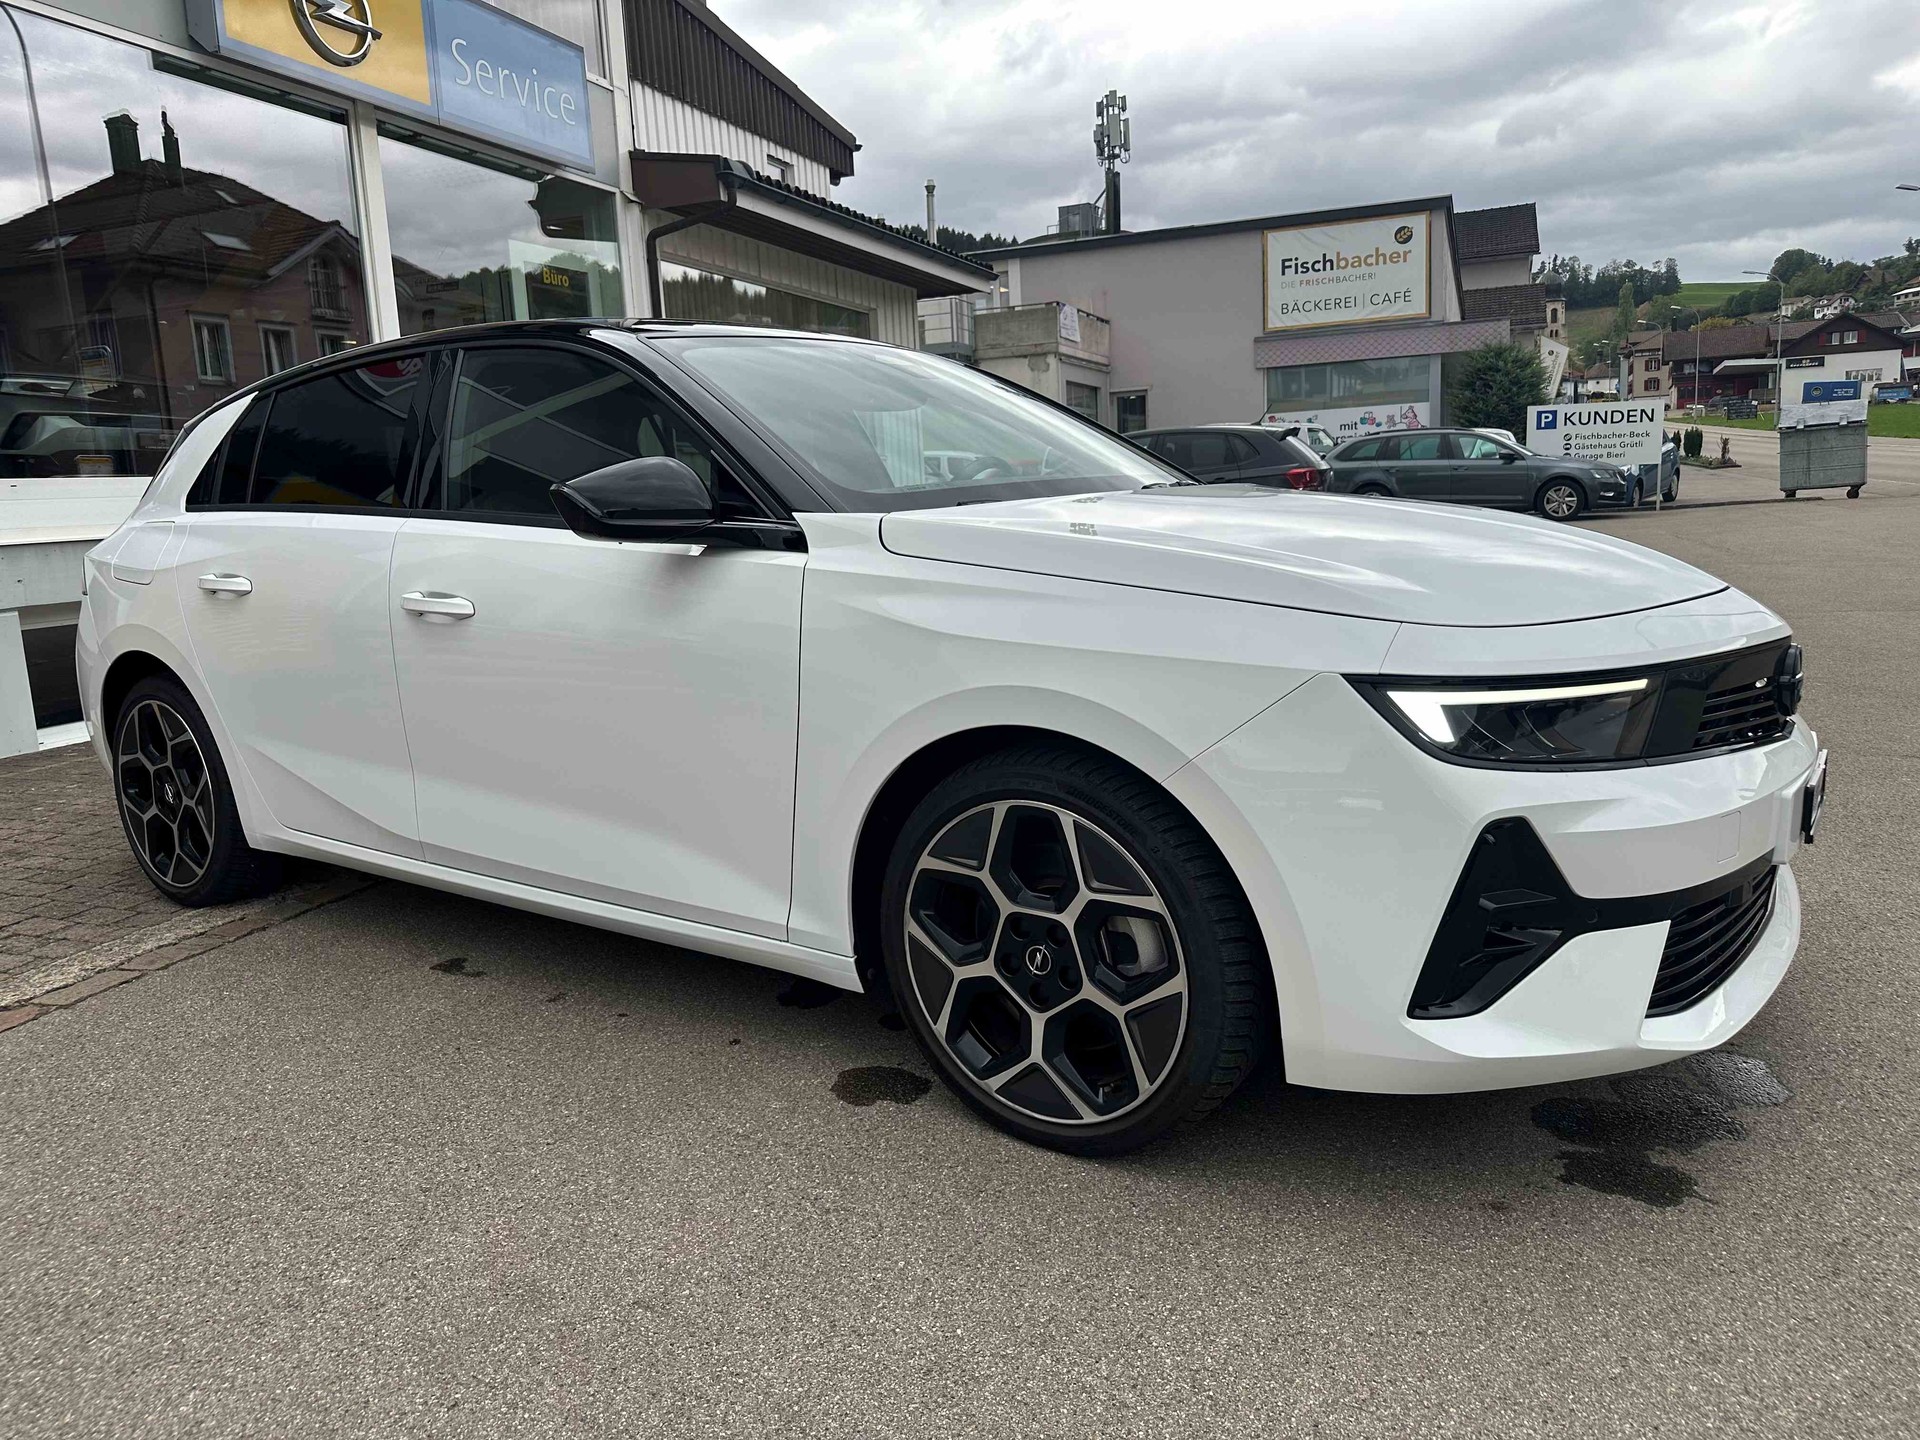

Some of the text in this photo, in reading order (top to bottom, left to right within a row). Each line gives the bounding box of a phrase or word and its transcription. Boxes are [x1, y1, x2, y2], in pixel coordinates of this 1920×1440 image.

[450, 38, 576, 126] Service
[1280, 247, 1412, 276] Fischbacher
[543, 266, 570, 287] Büro
[1280, 280, 1296, 289] DIE
[1280, 288, 1412, 315] BÄCKEREI CAFÉ
[1541, 408, 1655, 428] P KUNDEN
[1339, 421, 1358, 431] mit
[1575, 431, 1651, 441] Fischbacher-Beck
[1574, 440, 1643, 451] Gästehaus Grütli
[1573, 451, 1626, 461] Garage Bieri
